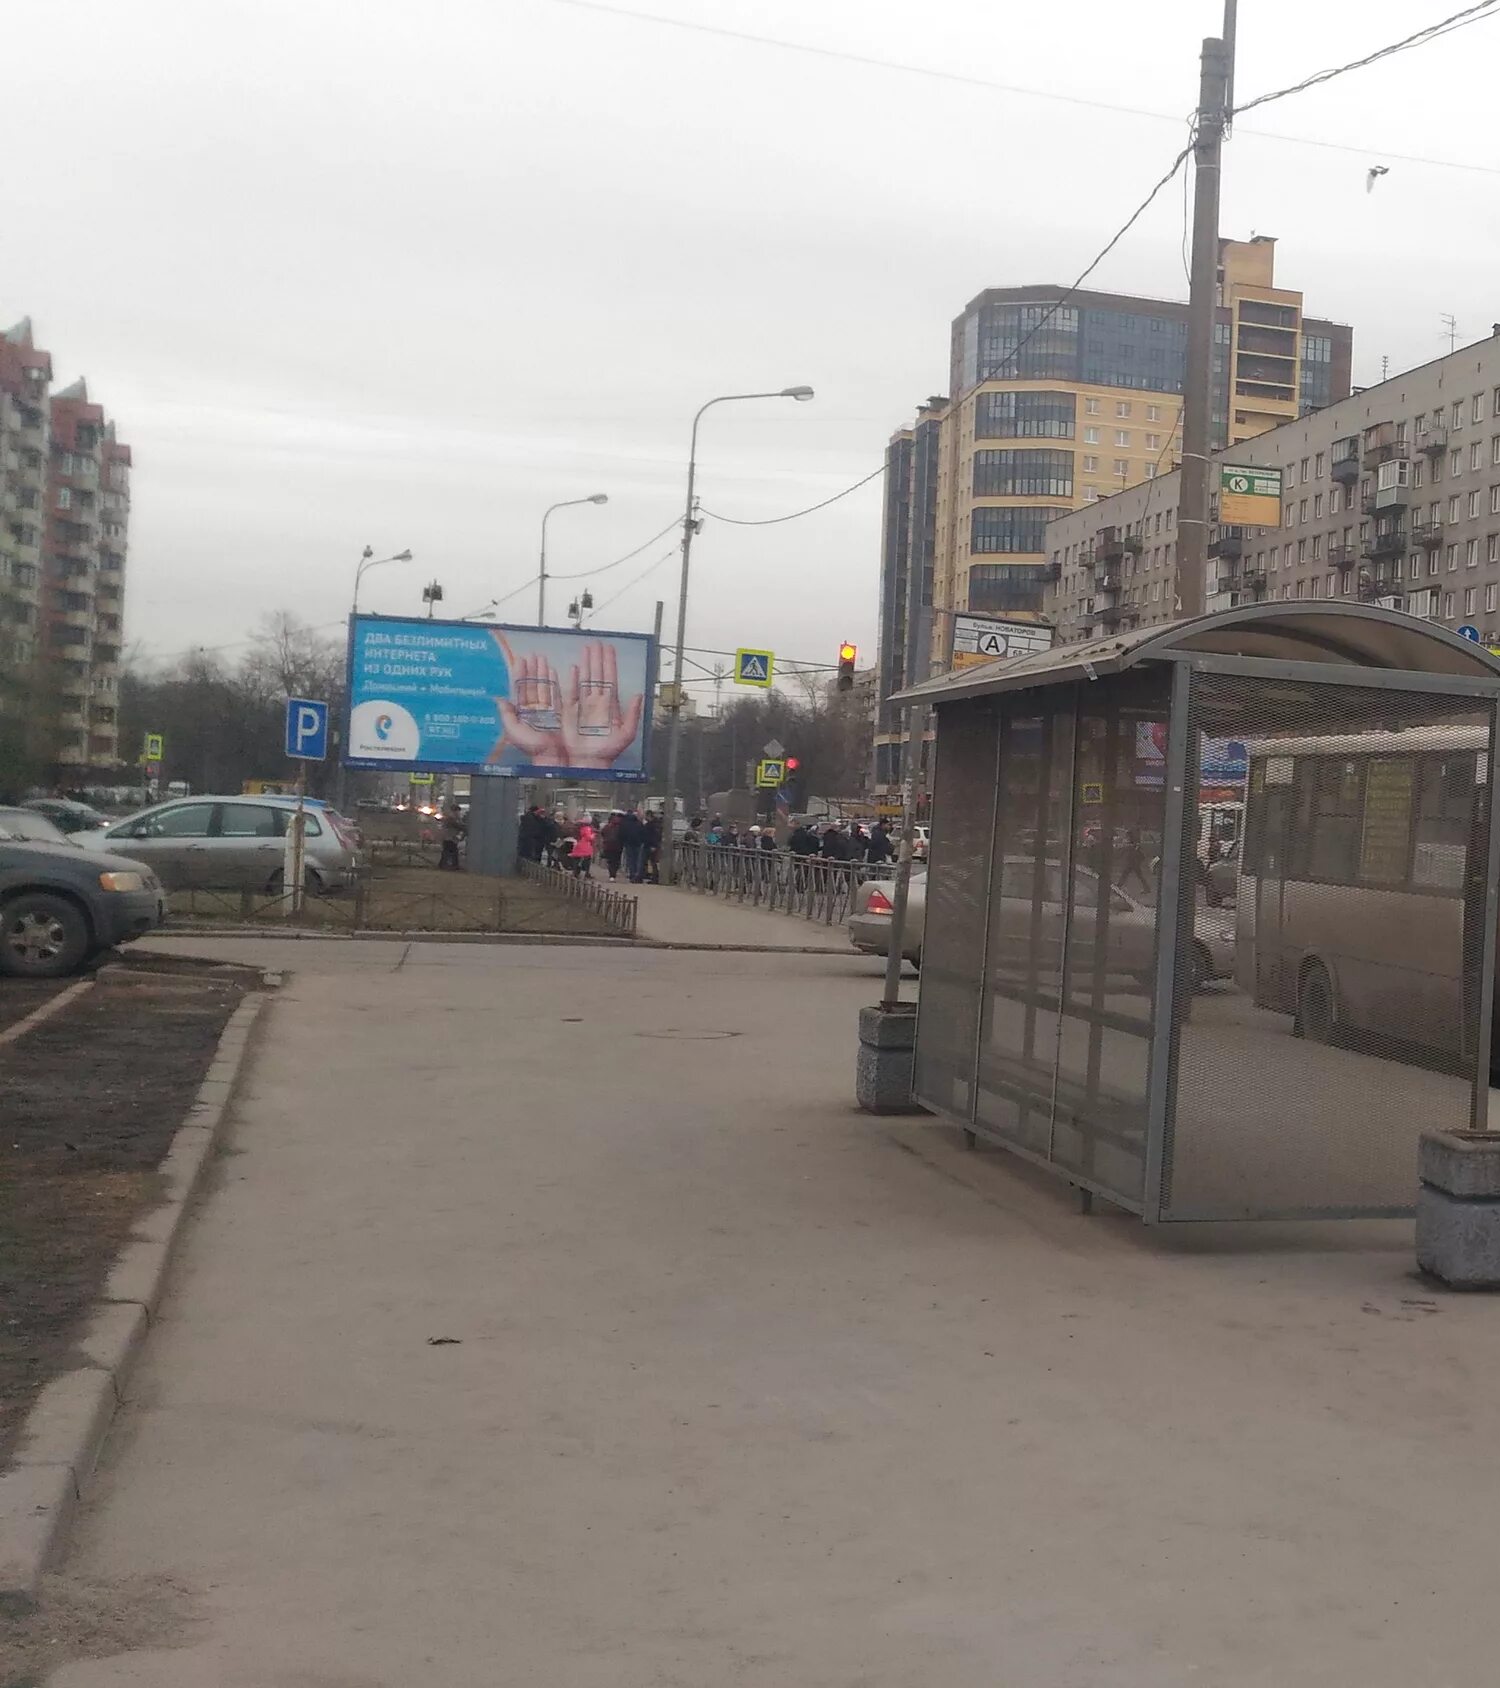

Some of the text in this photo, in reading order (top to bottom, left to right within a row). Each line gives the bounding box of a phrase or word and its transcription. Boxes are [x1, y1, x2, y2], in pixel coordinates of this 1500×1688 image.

[1234, 478, 1244, 491] К
[995, 625, 1036, 636] НОВАТОРОВ
[364, 632, 488, 650] ДВА БЕЗЛИМИТНЫХ
[985, 635, 1000, 653] А
[364, 648, 437, 662] ИНТЕРНЕТА
[363, 664, 453, 678] ИЗ ОДНИХ РУК
